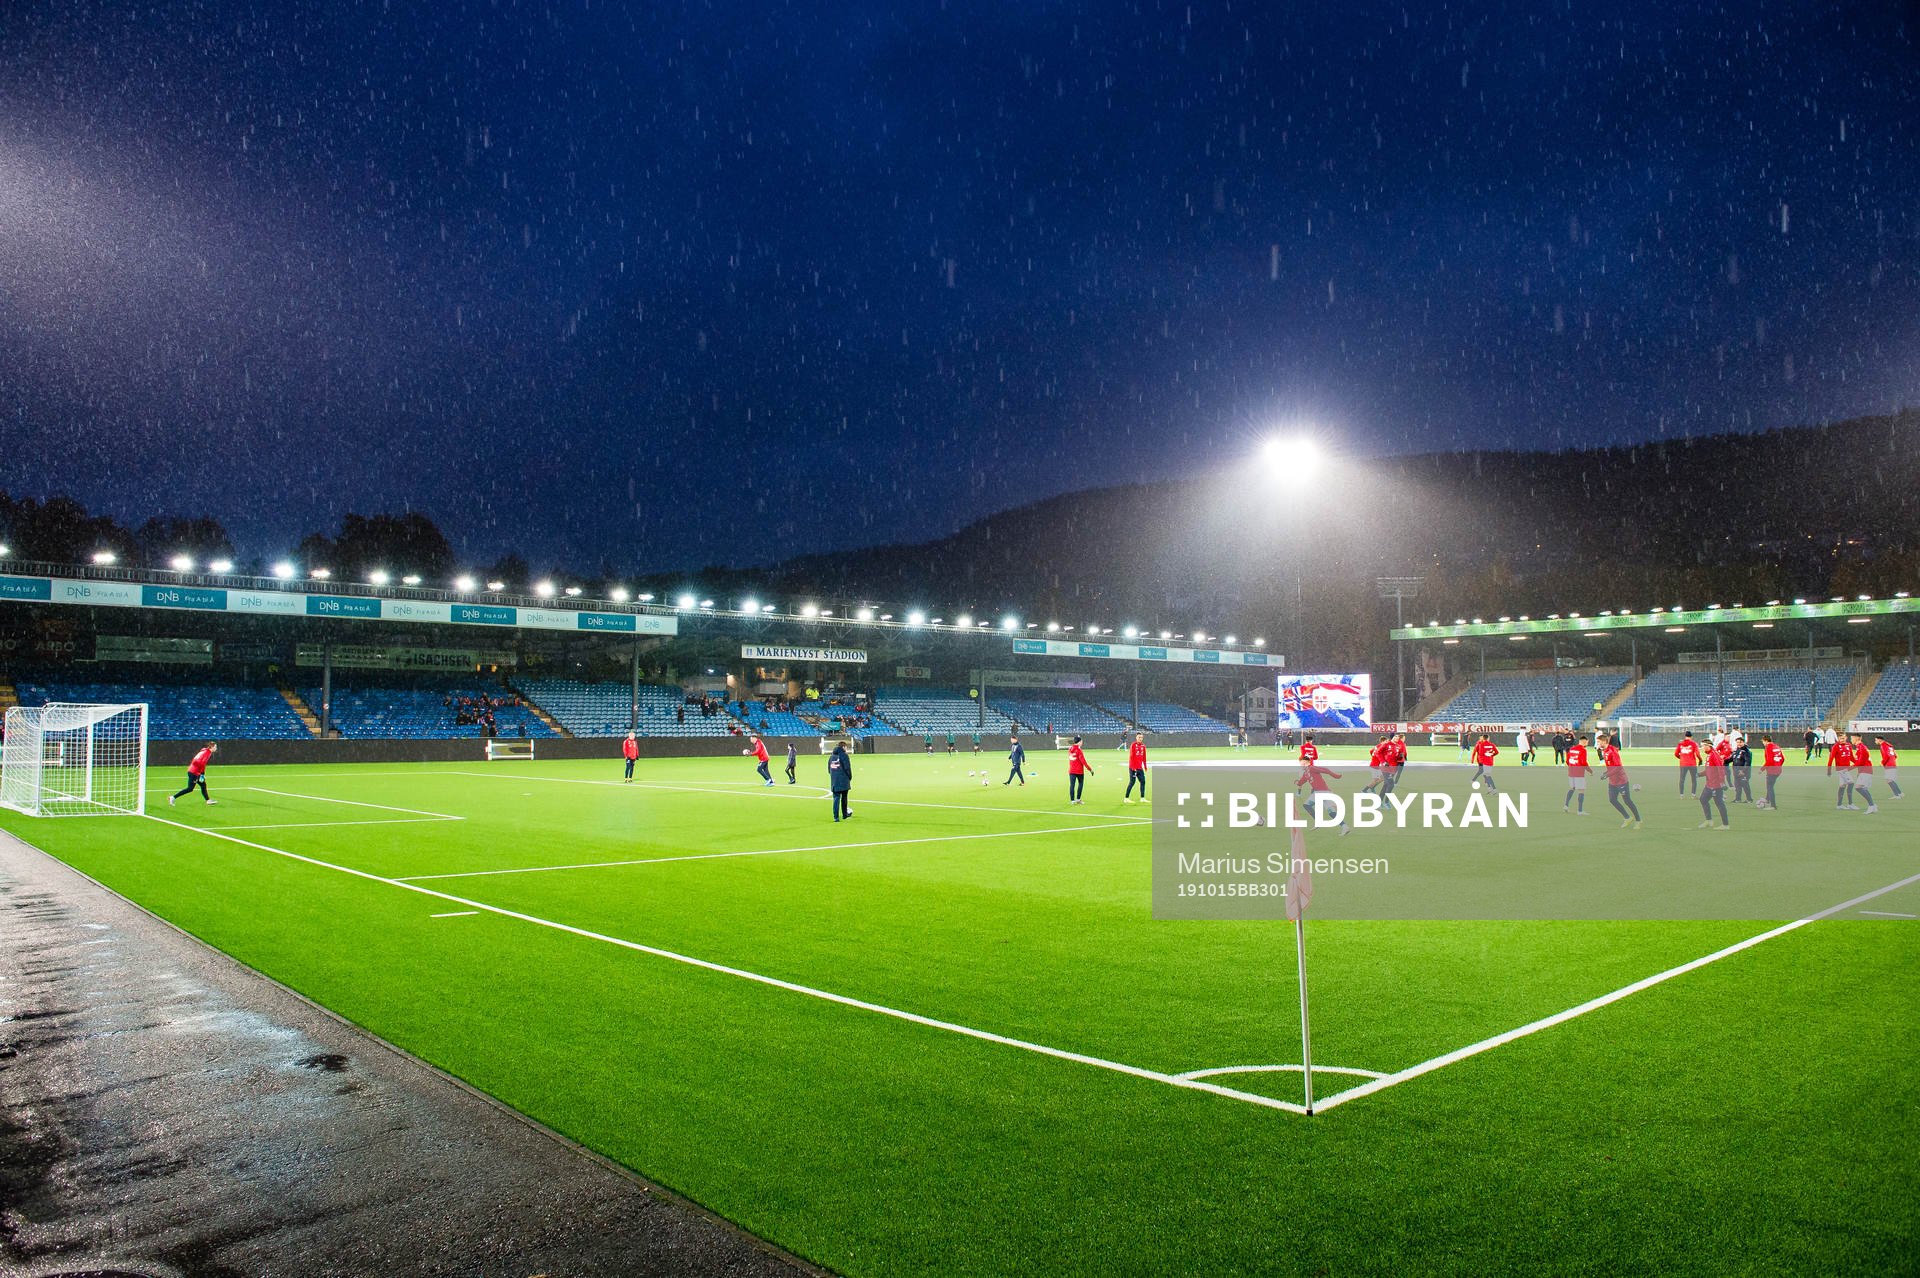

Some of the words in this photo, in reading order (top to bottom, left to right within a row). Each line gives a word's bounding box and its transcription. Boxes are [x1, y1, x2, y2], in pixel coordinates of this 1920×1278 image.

[67, 584, 91, 599] DNB
[156, 590, 180, 604] DNB
[241, 595, 262, 608] DNB
[319, 600, 340, 612] DNB
[393, 604, 412, 616] DNB
[462, 608, 480, 620] DNB
[527, 612, 544, 624] DNB
[587, 616, 604, 627] DNB
[644, 618, 660, 630] DNB
[413, 653, 471, 667] ISACHSEN
[756, 647, 820, 659] MARIENLYST
[823, 649, 865, 661] STADION
[1386, 724, 1396, 732] AS
[1467, 723, 1504, 733] Canon
